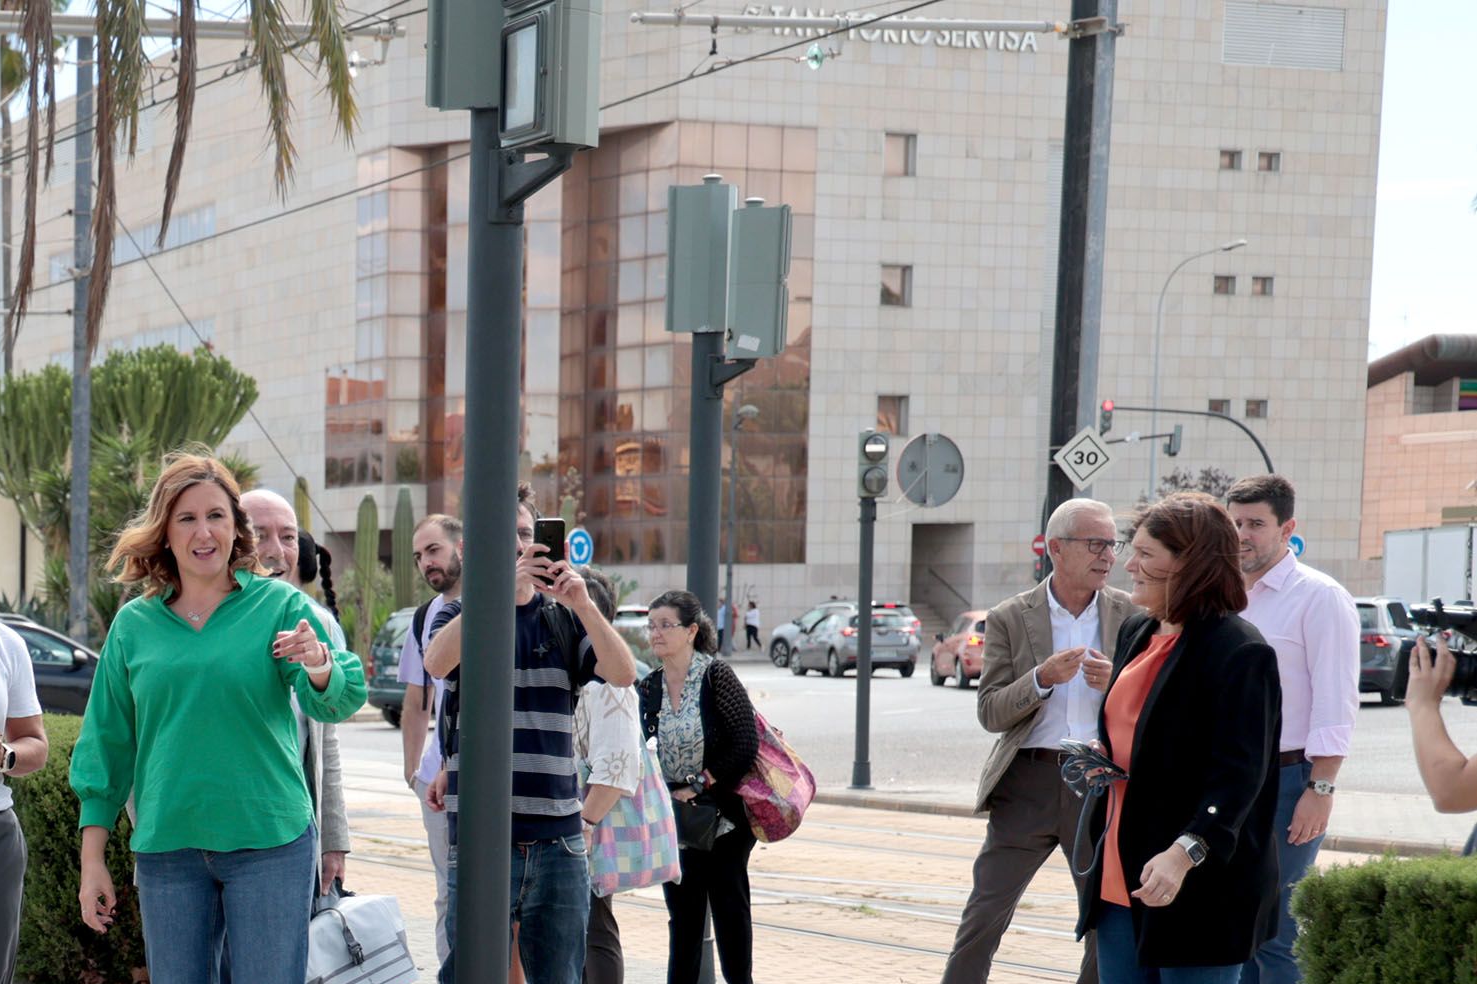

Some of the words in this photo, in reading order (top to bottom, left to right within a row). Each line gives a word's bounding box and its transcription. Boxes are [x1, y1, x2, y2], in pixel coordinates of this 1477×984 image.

[771, 5, 931, 44] TANTORIO
[935, 18, 1038, 52] SERVISA
[1074, 451, 1098, 465] 30
